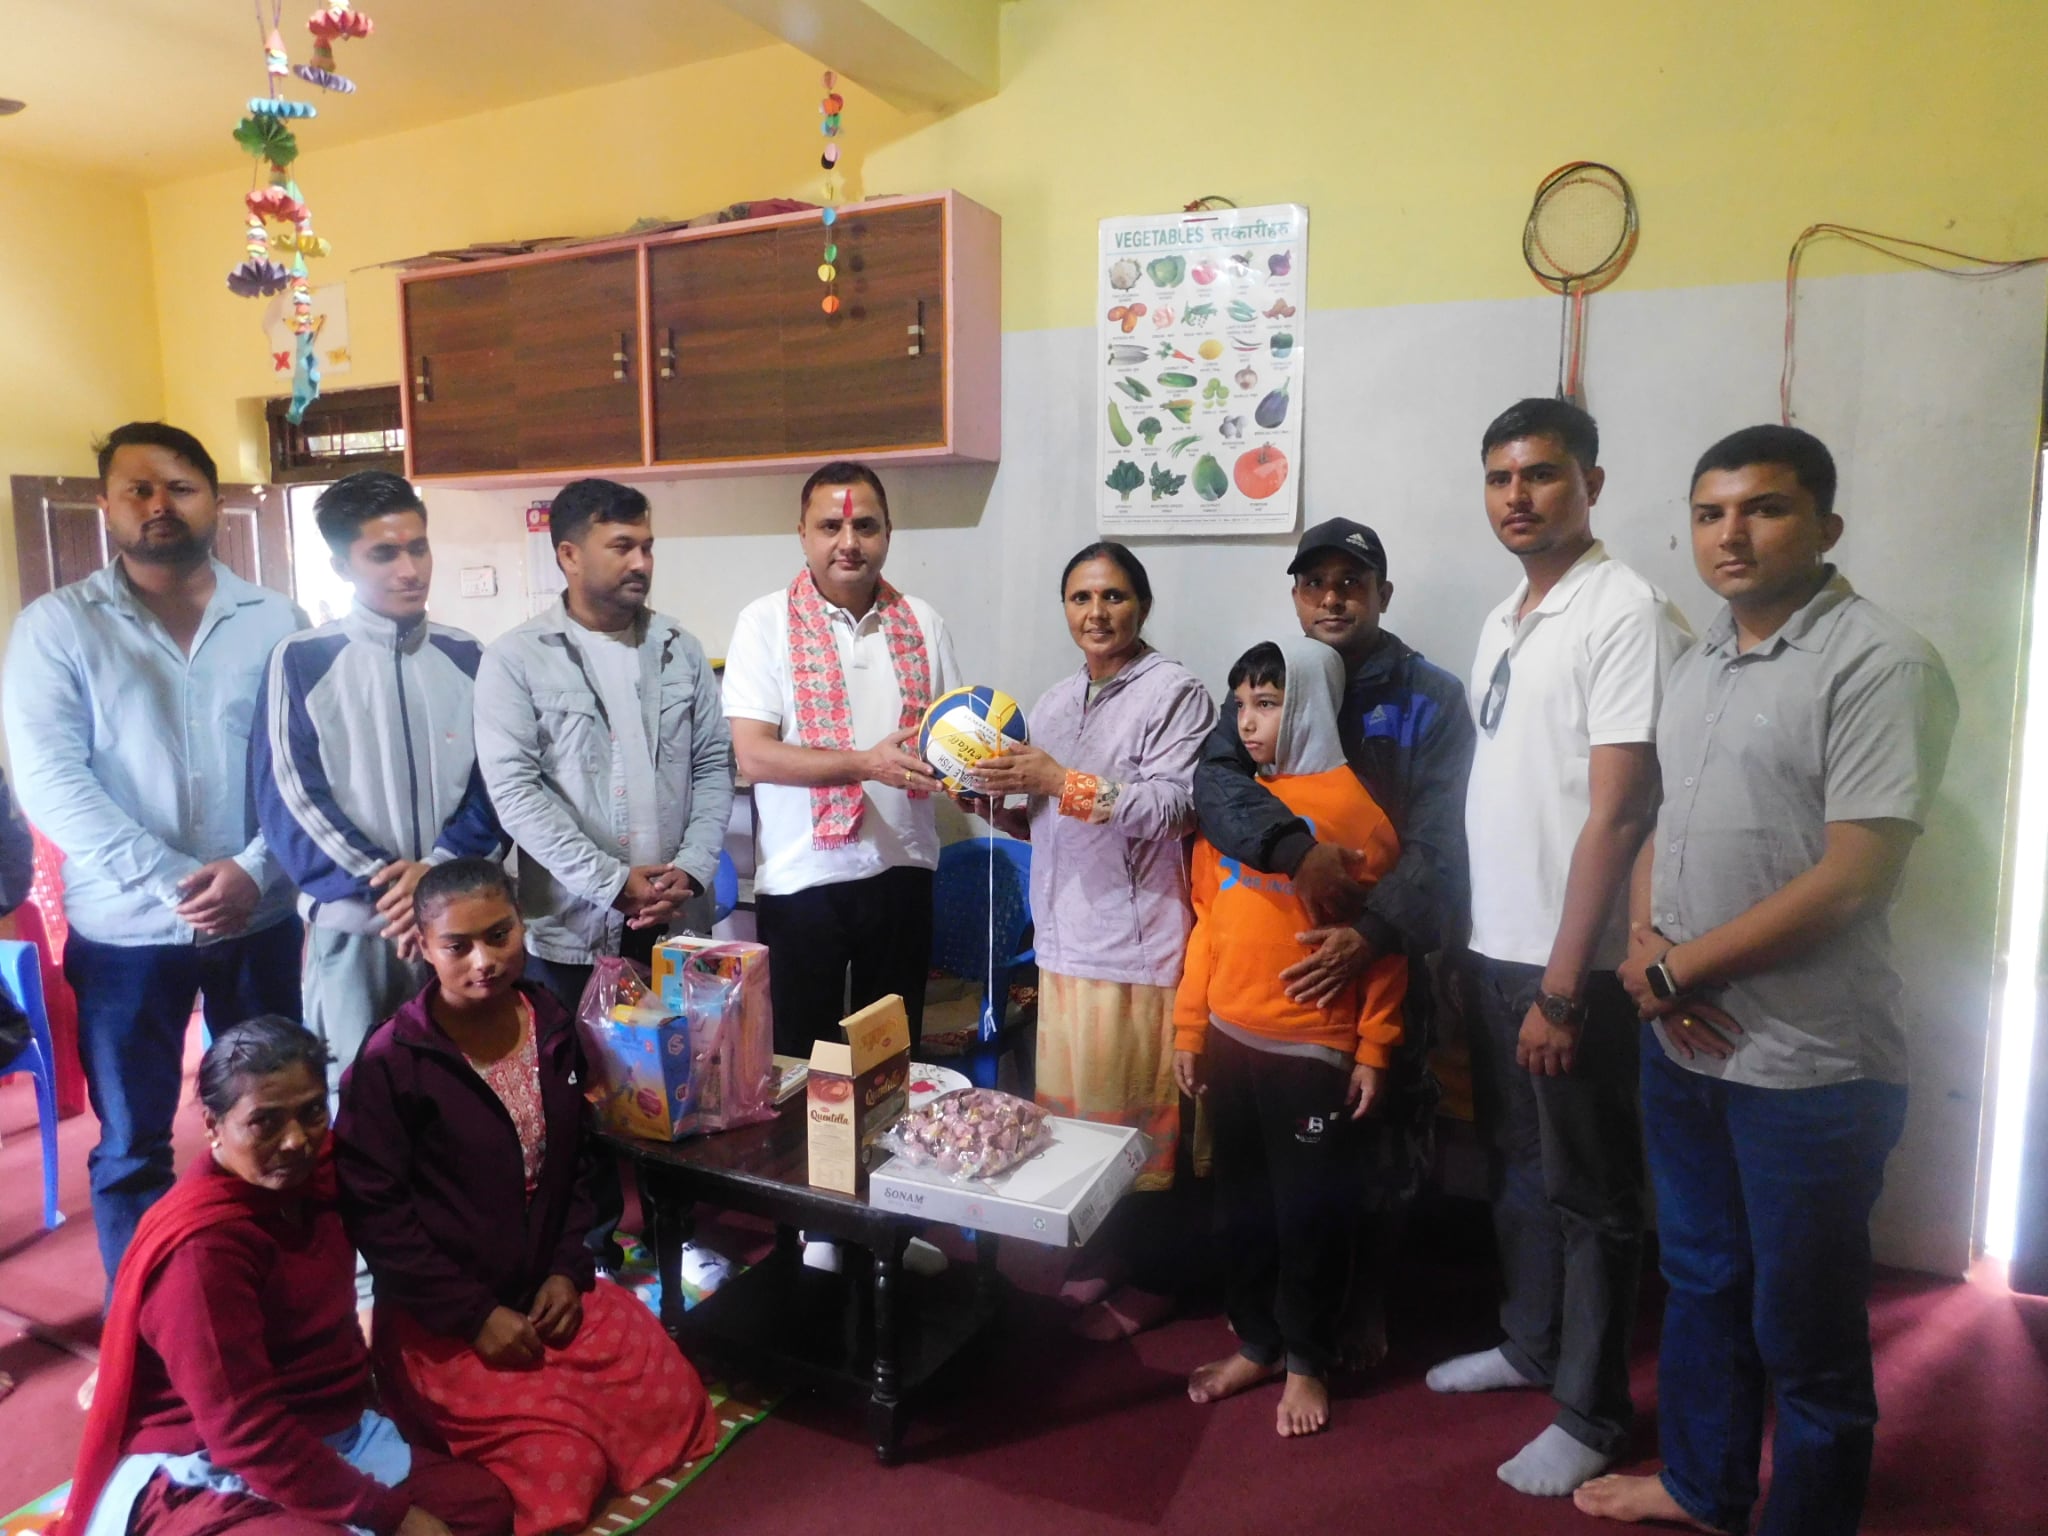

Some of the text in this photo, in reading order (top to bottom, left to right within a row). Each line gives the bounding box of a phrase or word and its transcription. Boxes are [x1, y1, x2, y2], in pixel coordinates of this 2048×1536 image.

[1115, 226, 1205, 248] VEGETABLES
[938, 754, 953, 772] FISH
[884, 1187, 925, 1205] SONAM
